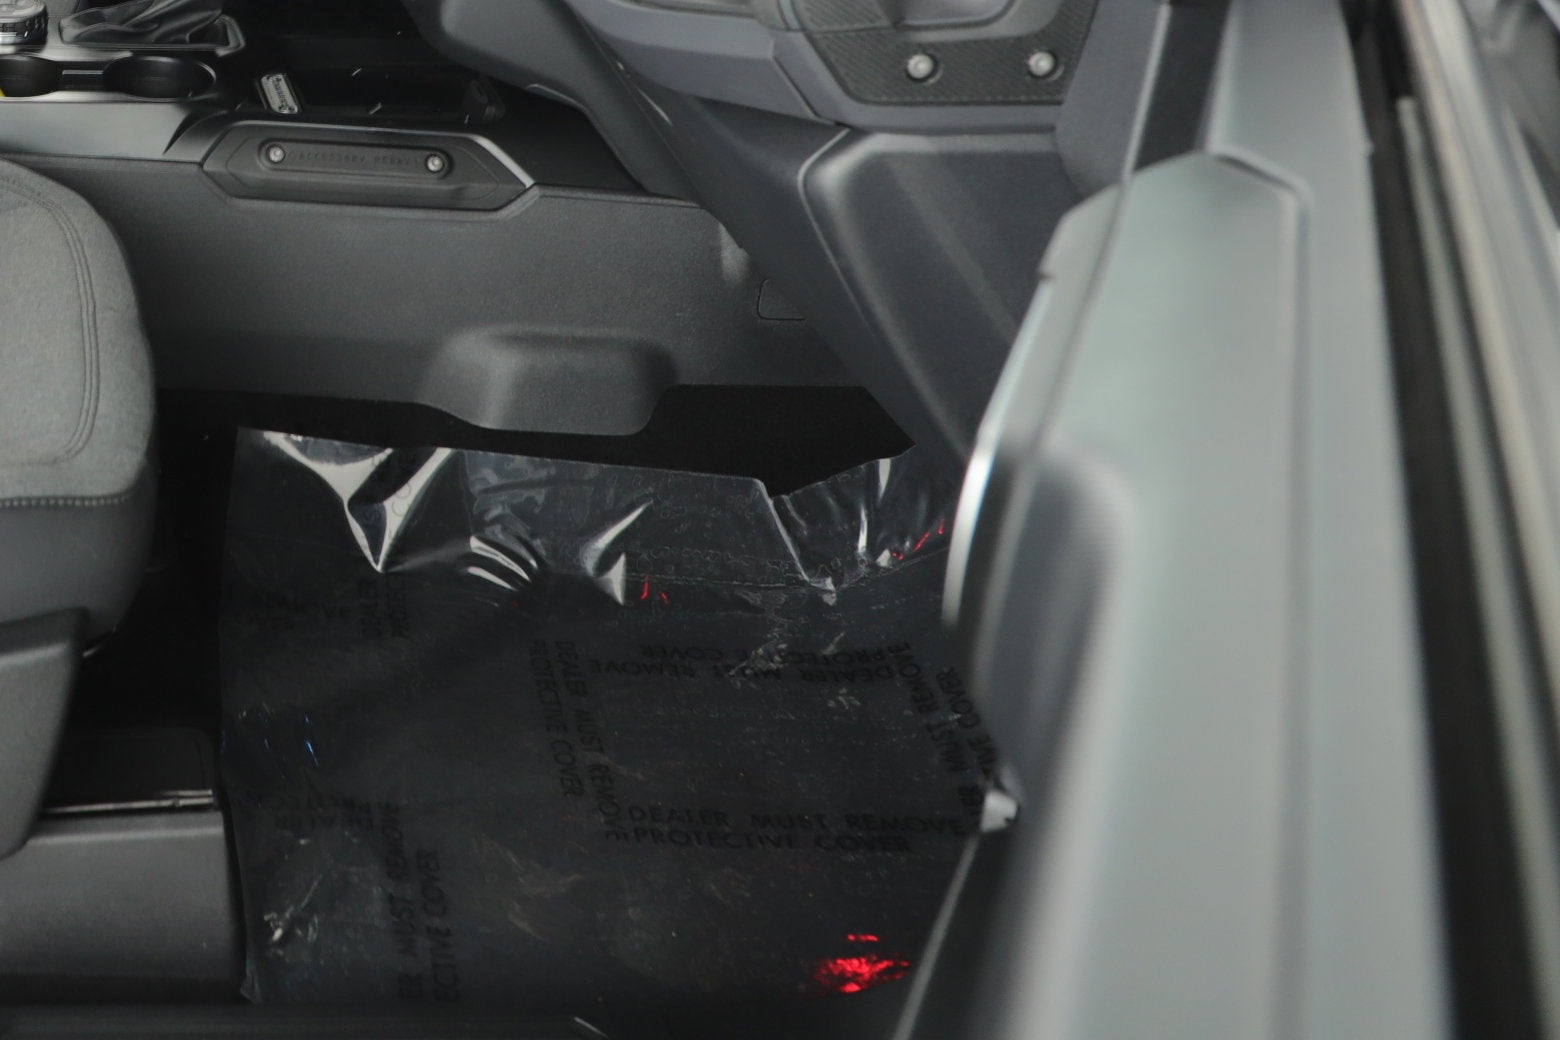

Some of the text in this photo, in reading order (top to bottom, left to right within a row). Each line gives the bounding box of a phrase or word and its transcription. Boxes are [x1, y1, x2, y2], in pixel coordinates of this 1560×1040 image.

[587, 658, 697, 679] REMOVE
[639, 643, 725, 663] COVER
[800, 664, 894, 683] DEALER
[888, 641, 939, 715] REMOVE
[528, 638, 586, 798] PROTECTIVE COVER
[935, 667, 983, 729] COVER
[555, 640, 589, 699] DEALER
[588, 763, 629, 844] REMOVE
[925, 722, 969, 774] MUST
[376, 801, 410, 883] REMOVE
[628, 804, 968, 837] DEALER MUST REMOVE
[633, 828, 913, 853] PROTECTIVE COVER
[415, 848, 448, 918] COVER
[387, 893, 419, 957] MUST
